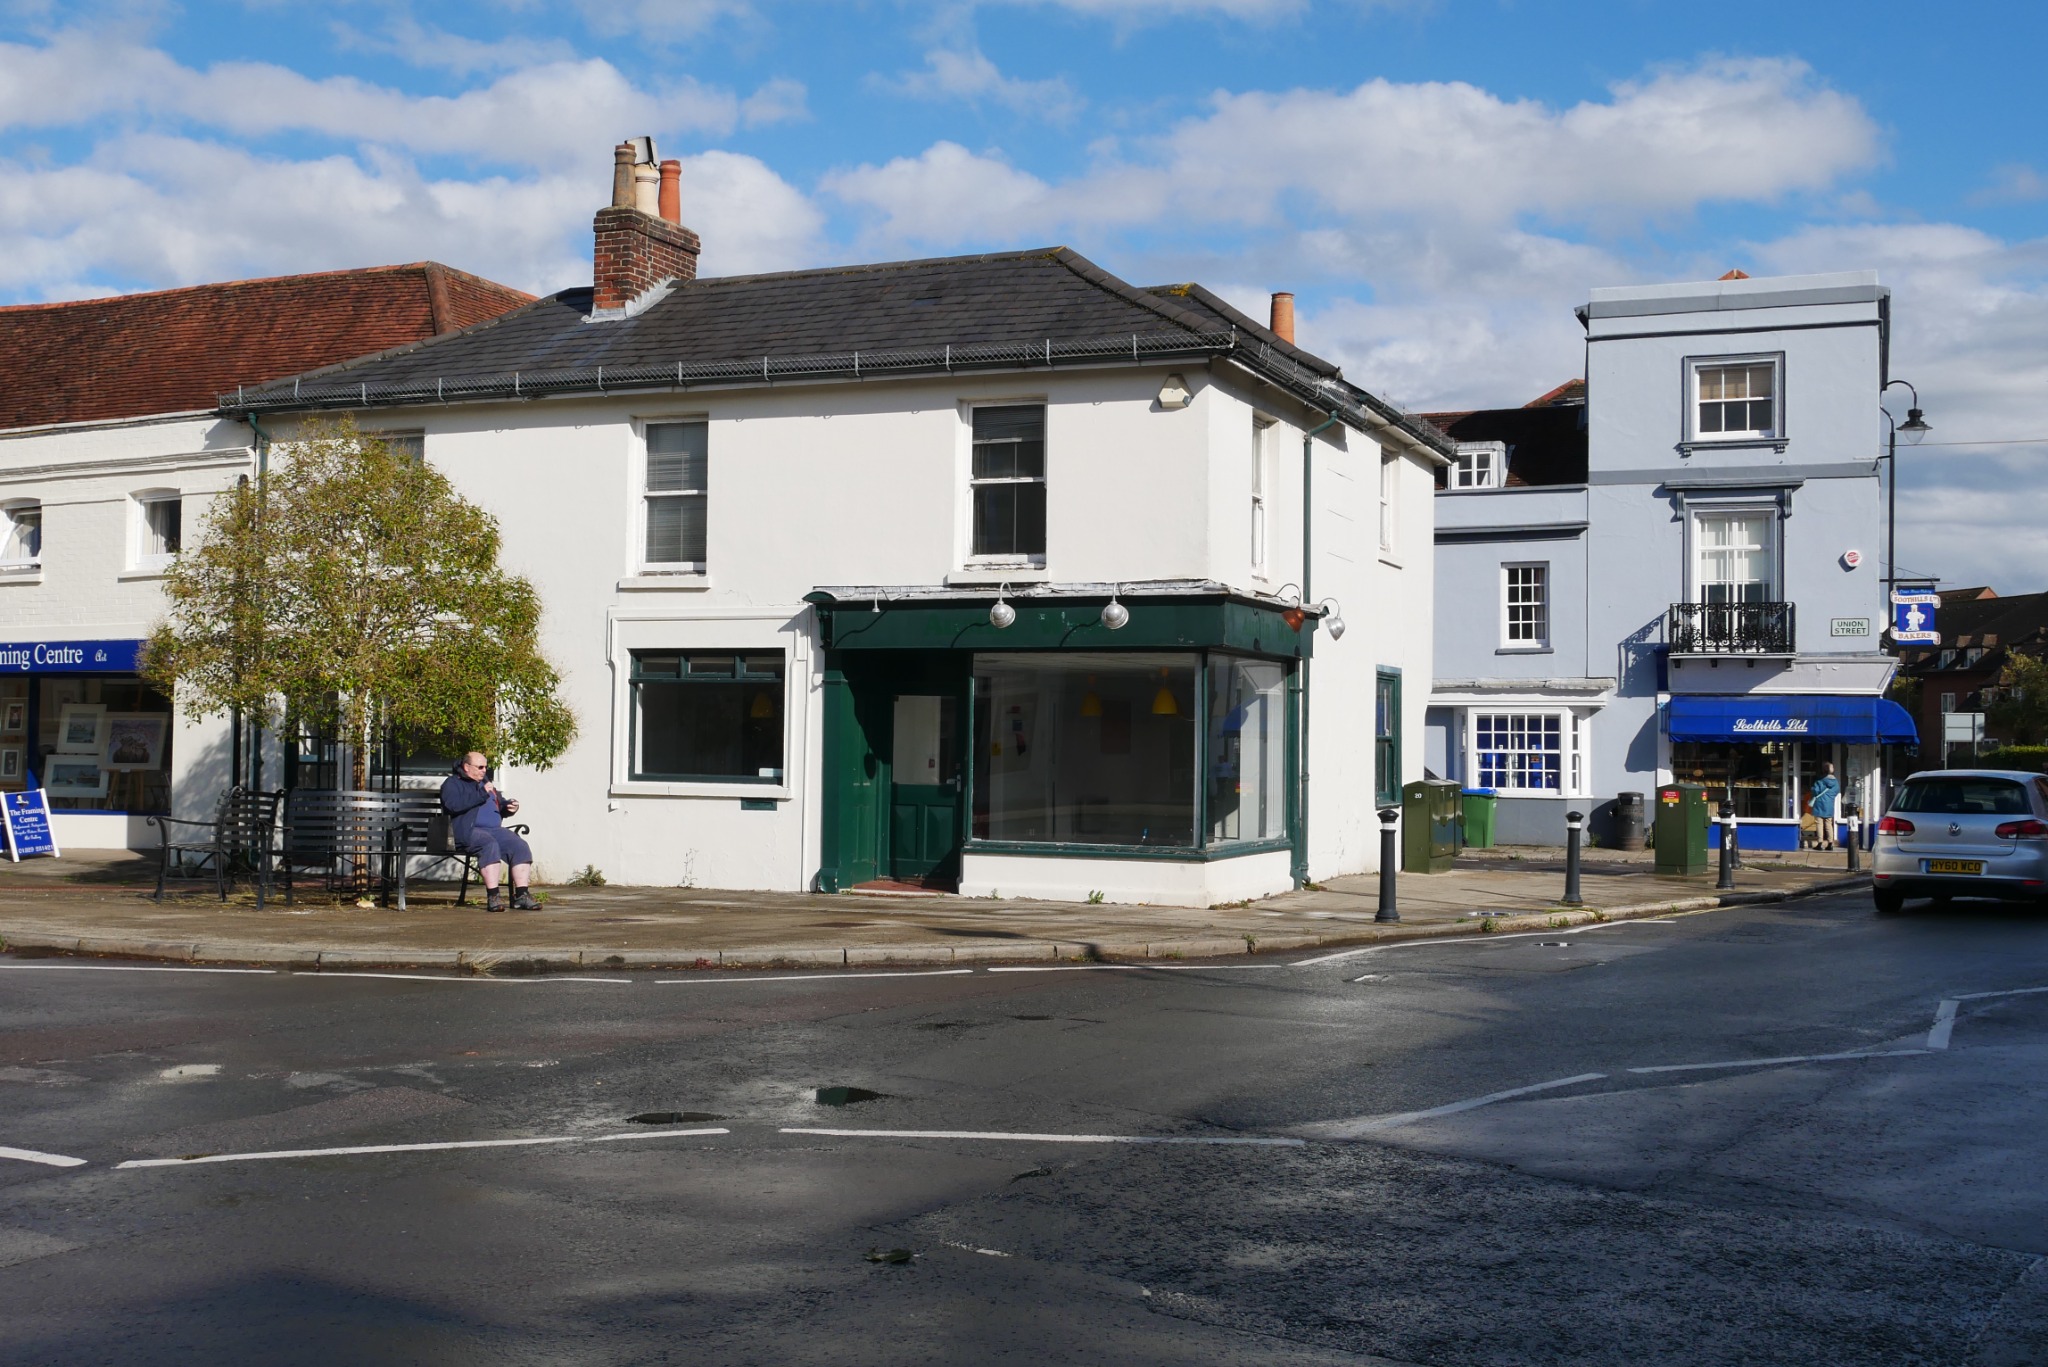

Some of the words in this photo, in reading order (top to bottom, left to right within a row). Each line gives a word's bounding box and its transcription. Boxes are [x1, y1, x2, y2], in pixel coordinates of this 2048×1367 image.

[35, 644, 83, 665] Centre
[1733, 718, 1781, 730] Soothills
[1931, 860, 1957, 871] HY60
